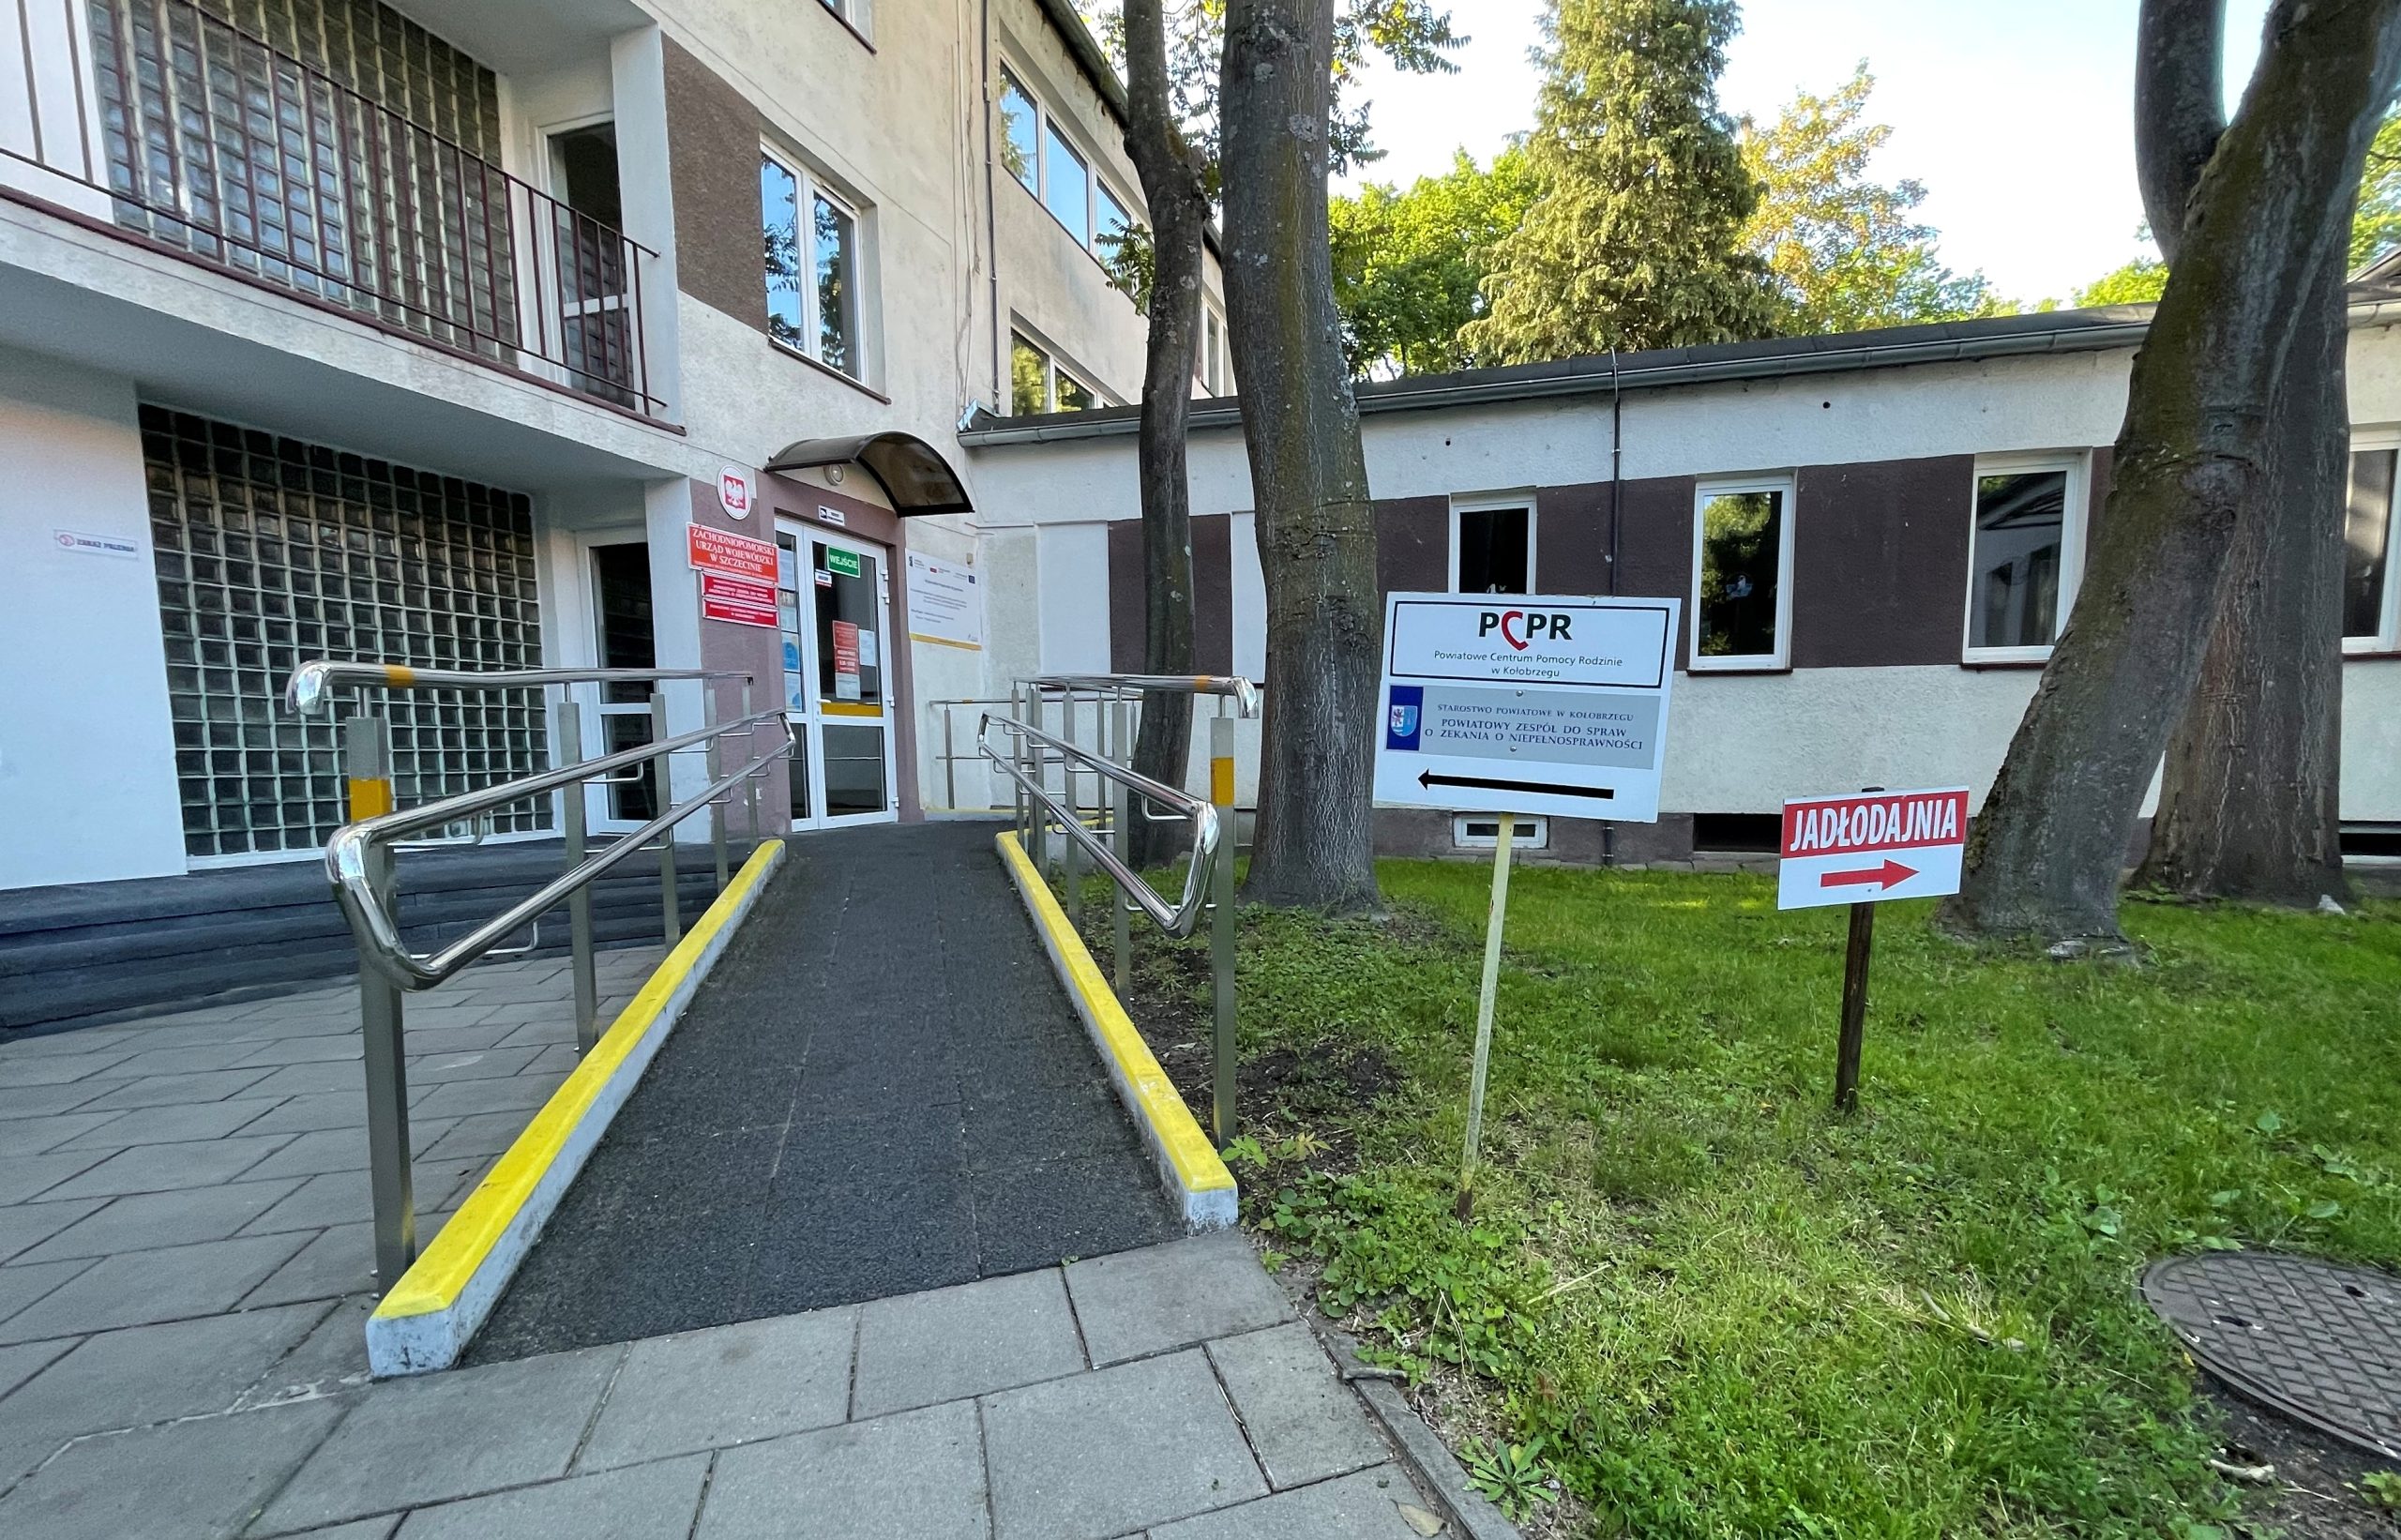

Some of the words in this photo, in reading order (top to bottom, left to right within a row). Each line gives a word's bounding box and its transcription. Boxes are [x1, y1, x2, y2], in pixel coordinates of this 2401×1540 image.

[693, 529, 775, 555] ZACHODNIOPOMORSKI
[696, 540, 724, 553] URZĄD
[725, 548, 774, 566] WOJEWÓDZKI
[710, 553, 718, 562] W
[719, 556, 763, 572] SZCZECINIE
[829, 554, 857, 569] WEJŚCIE
[1479, 611, 1573, 651] PCPR
[1434, 650, 1487, 661] Powiatowe
[1490, 652, 1533, 662] Centrum
[1536, 654, 1576, 666] Pomocy
[1578, 656, 1623, 666] Rodzinie
[1438, 703, 1492, 714] STAROSTWO
[1496, 707, 1552, 717] POWIATOWE
[1442, 718, 1511, 730] POWIATOWY
[1563, 726, 1581, 734] DO
[1586, 727, 1627, 737] SPRAW
[1495, 732, 1504, 741] O
[1789, 798, 1957, 852] JADŁODAJNIA
